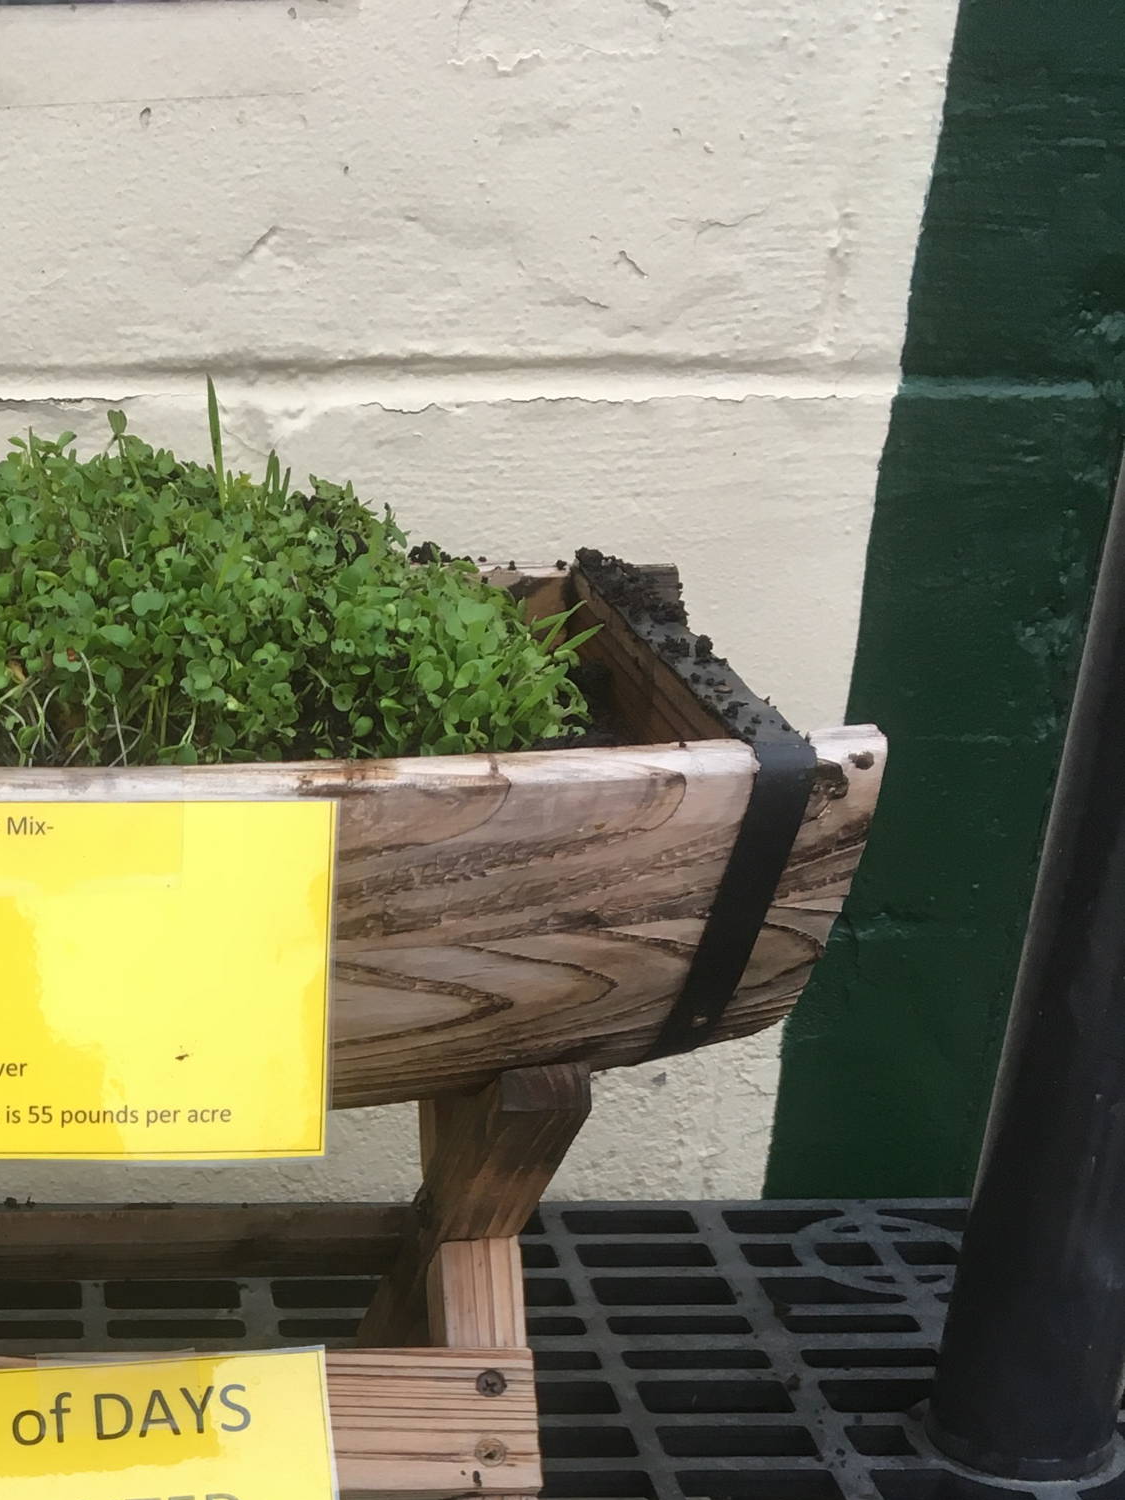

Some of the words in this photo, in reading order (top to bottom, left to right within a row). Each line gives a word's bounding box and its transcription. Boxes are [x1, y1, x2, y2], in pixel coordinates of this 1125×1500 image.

[7, 815, 55, 837] Mix-
[6, 1106, 21, 1125] is
[28, 1105, 53, 1125] 55
[61, 1104, 139, 1129] pounds
[145, 1109, 180, 1129] per
[187, 1108, 232, 1125] acre
[12, 1391, 73, 1446] of
[93, 1384, 252, 1441] DAYS
